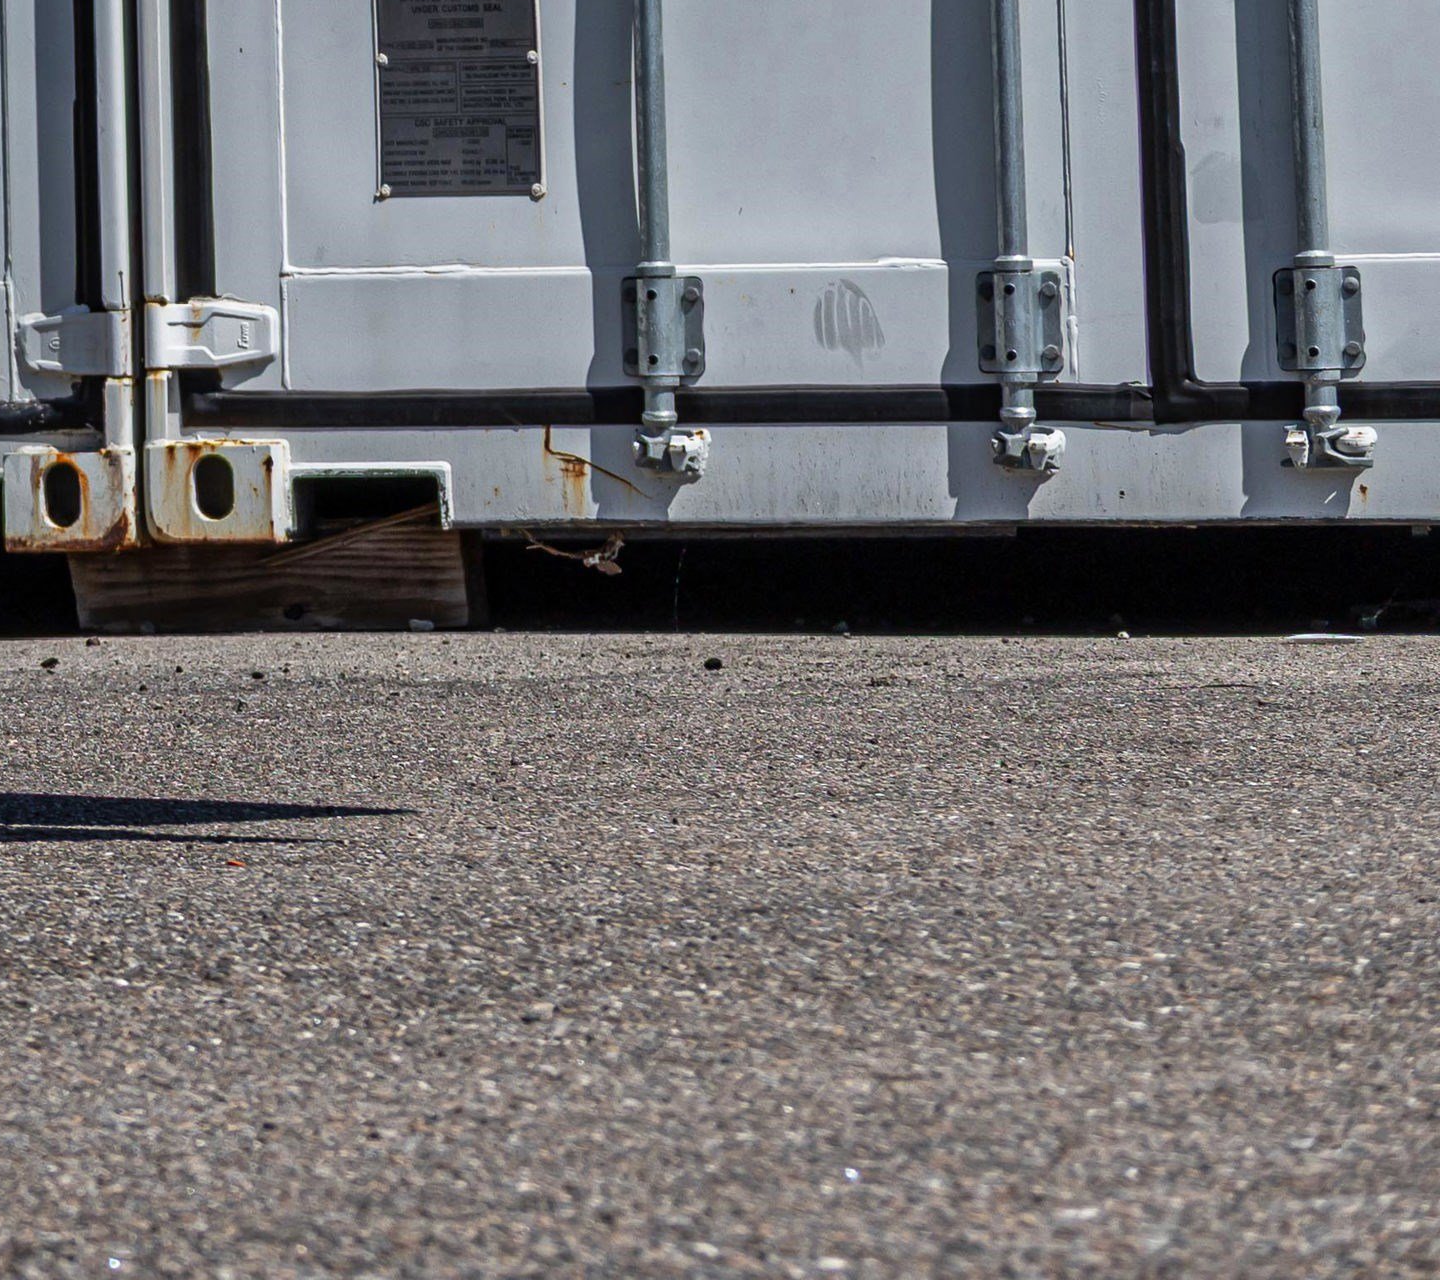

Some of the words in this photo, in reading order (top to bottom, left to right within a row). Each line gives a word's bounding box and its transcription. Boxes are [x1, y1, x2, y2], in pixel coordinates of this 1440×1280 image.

[411, 4, 439, 14] UNDER
[441, 4, 480, 13] CUSTOMS
[483, 3, 502, 12] SEAL
[433, 117, 464, 126] SAFETY
[466, 116, 506, 126] APPROVAL
